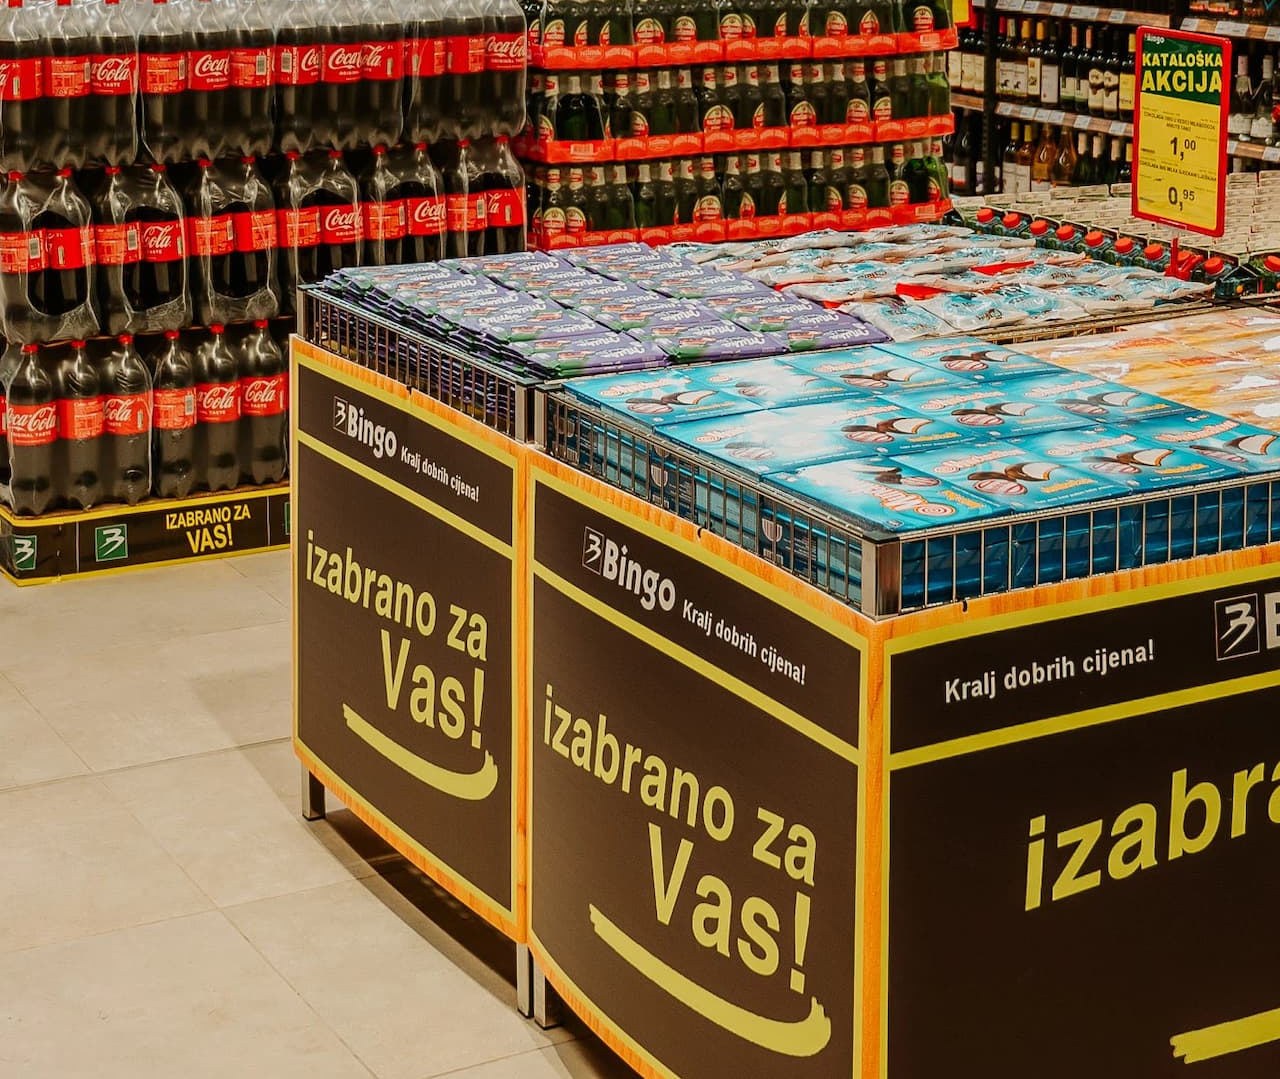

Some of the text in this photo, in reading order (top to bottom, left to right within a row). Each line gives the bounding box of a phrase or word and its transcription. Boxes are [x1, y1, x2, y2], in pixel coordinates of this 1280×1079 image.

[1141, 70, 1223, 93] AKCIJA
[1142, 50, 1223, 67] KATALOŠKA
[1170, 136, 1196, 161] 1,00
[1168, 186, 1195, 211] 0,95
[347, 403, 398, 458] Bingo
[401, 445, 480, 502] Kralj dobrih cijena!
[166, 504, 251, 530] IZABRANO ZA
[186, 523, 233, 554] VAS!
[305, 530, 489, 661] izabrano za
[602, 538, 676, 612] Bingo
[682, 599, 807, 686] Kralj dobrih cijena!
[945, 639, 1155, 703] Kralj dobrih cijena!
[381, 628, 486, 748] Vas!
[543, 686, 817, 887] izabrano za
[648, 823, 811, 995] Vas!
